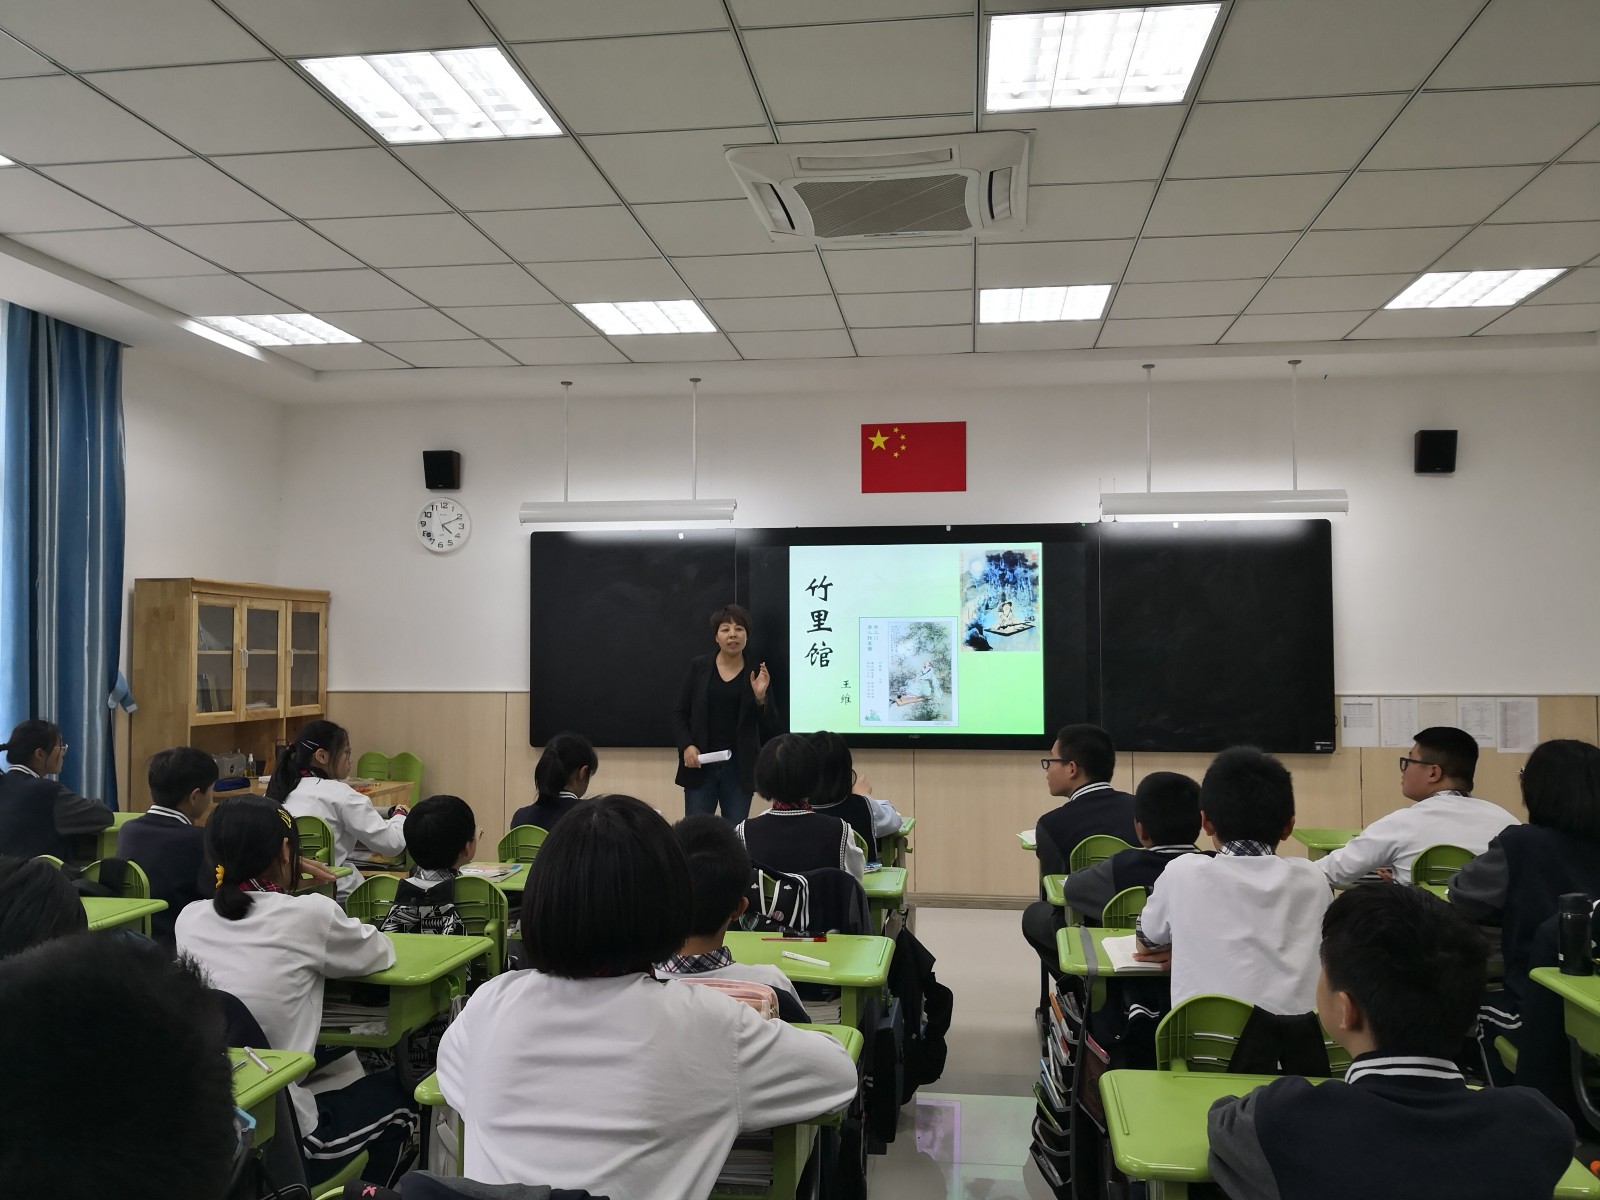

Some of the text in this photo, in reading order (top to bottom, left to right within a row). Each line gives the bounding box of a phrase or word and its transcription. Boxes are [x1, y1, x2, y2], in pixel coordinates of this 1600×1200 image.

[429, 537, 436, 545] 7
[804, 574, 834, 668] 竹里馆
[840, 679, 852, 707] 王维
